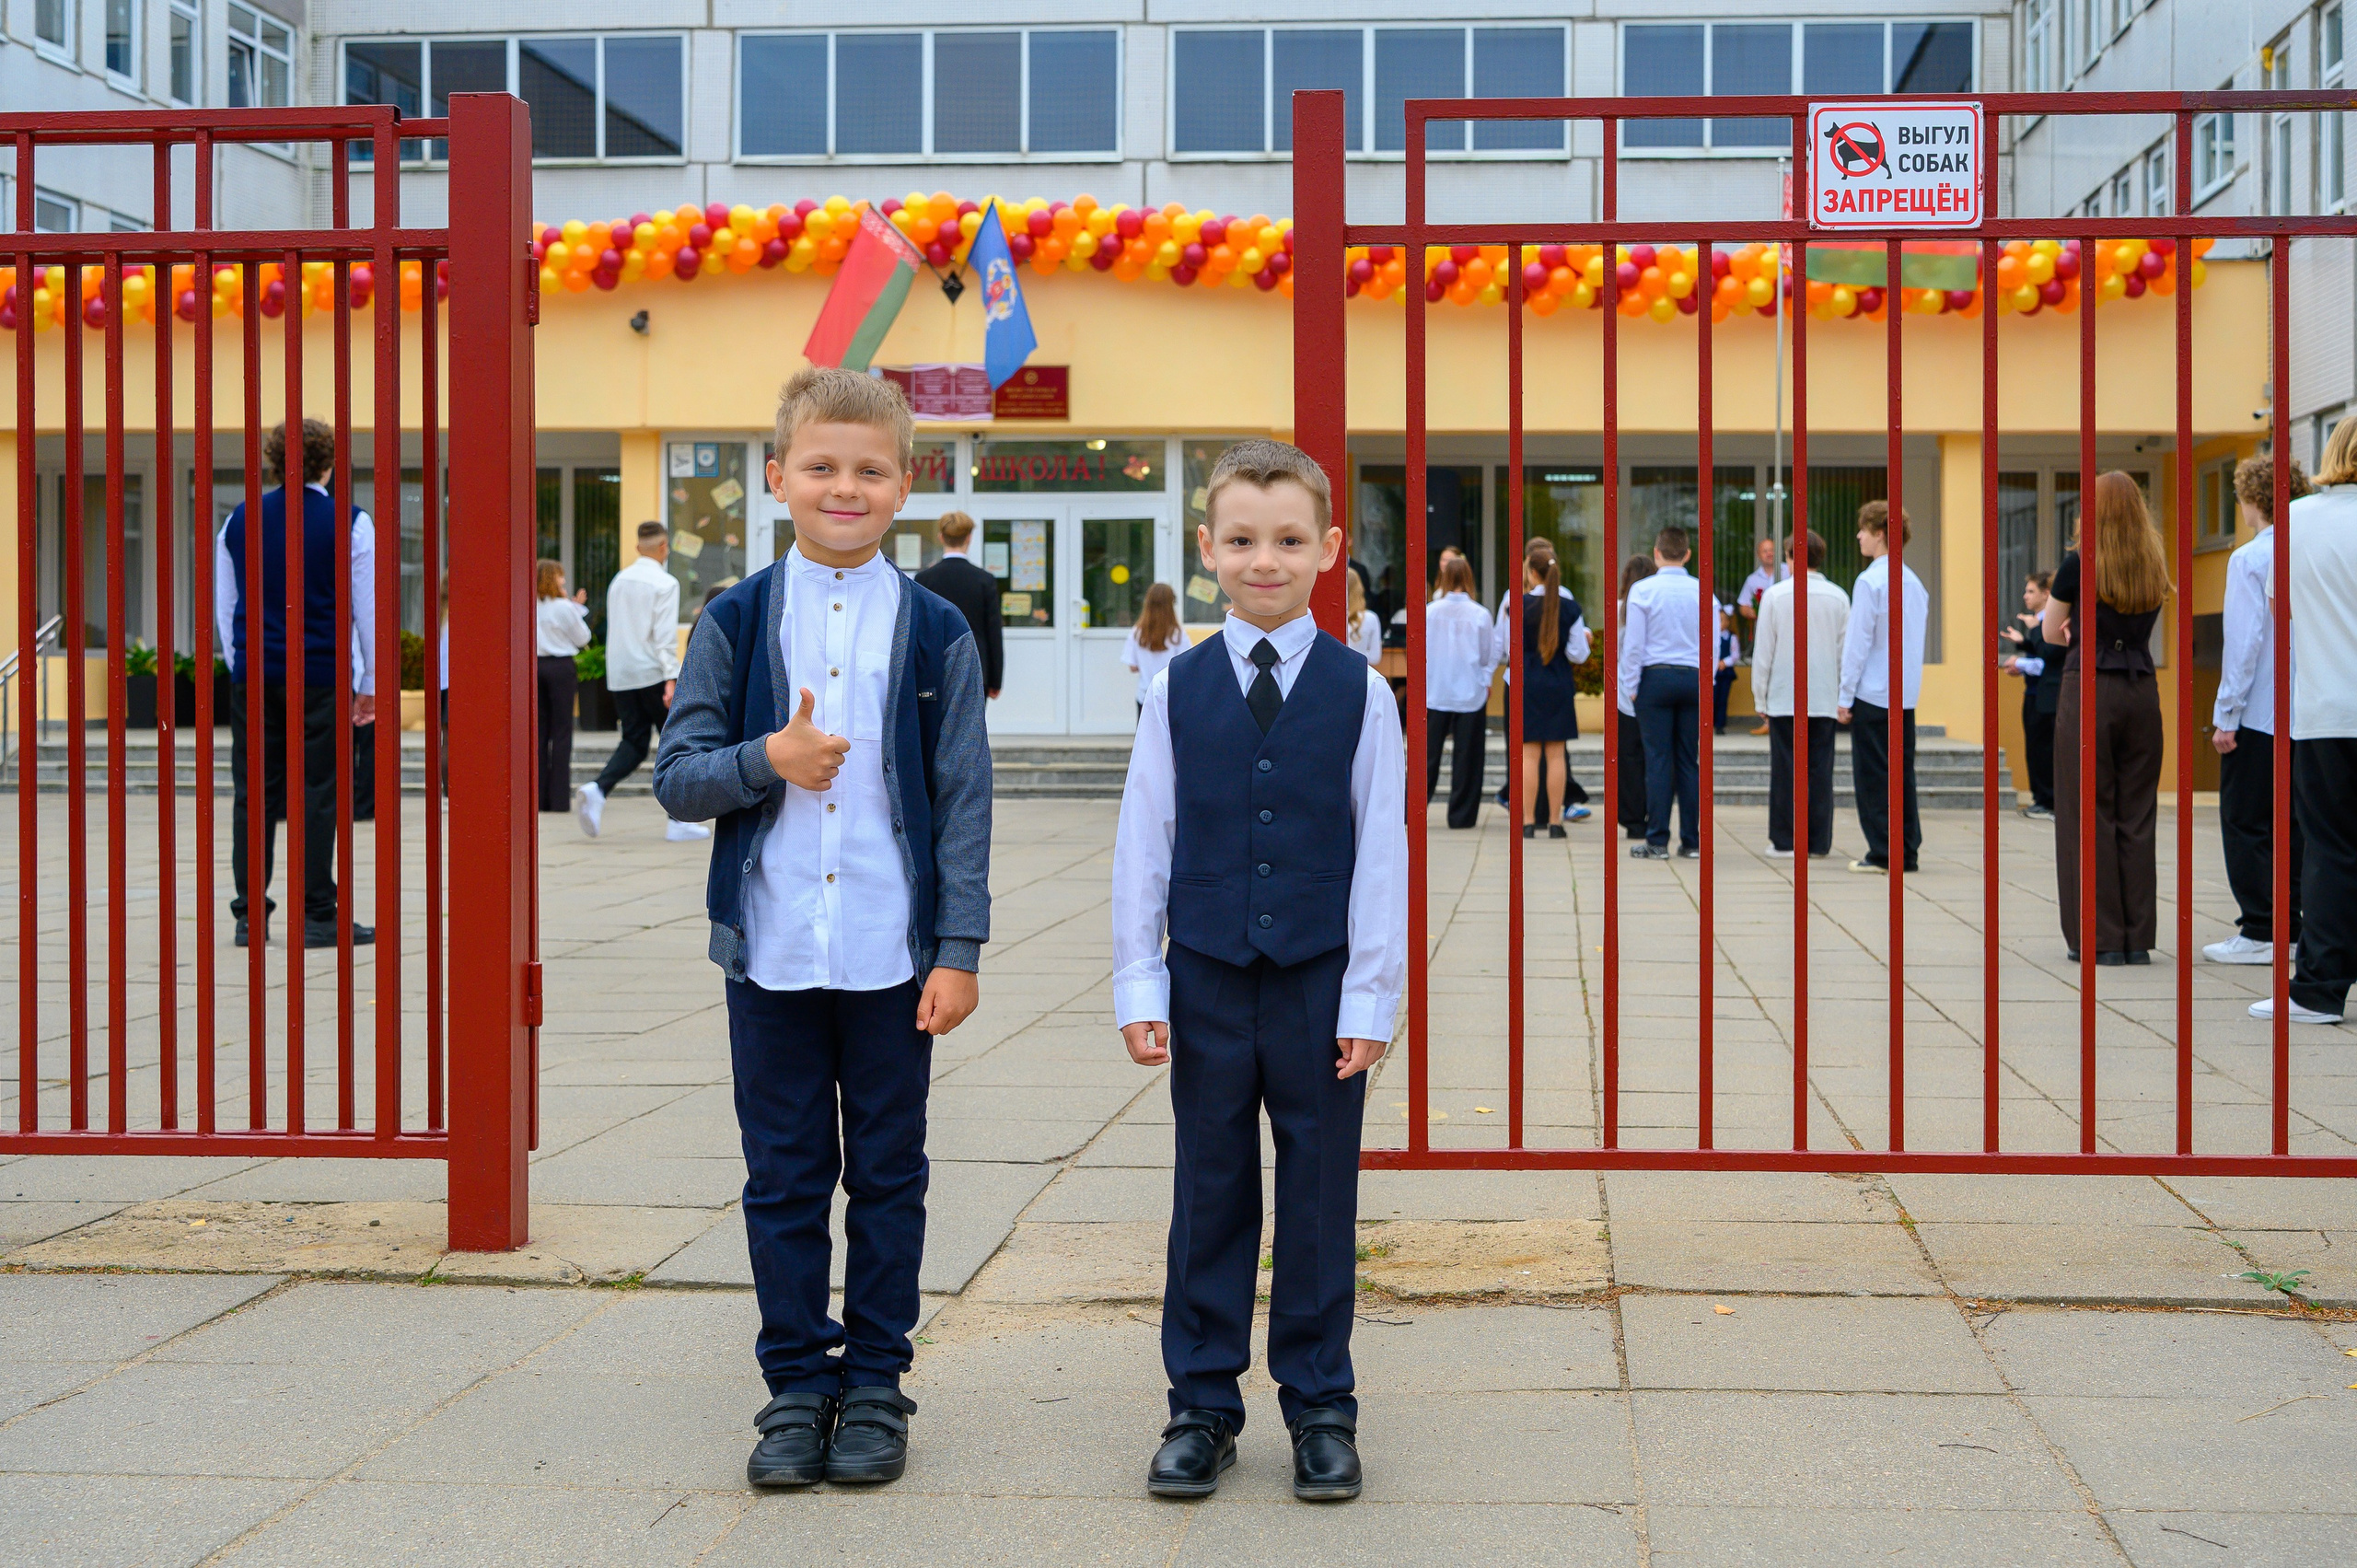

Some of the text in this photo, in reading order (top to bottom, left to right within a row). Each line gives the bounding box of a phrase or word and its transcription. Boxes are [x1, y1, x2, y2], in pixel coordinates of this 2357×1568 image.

[1898, 126, 1969, 145] ВЫГУЛ
[1898, 153, 1969, 173] СОБАК
[1823, 182, 1969, 216] ЗАПРЕЩЁН
